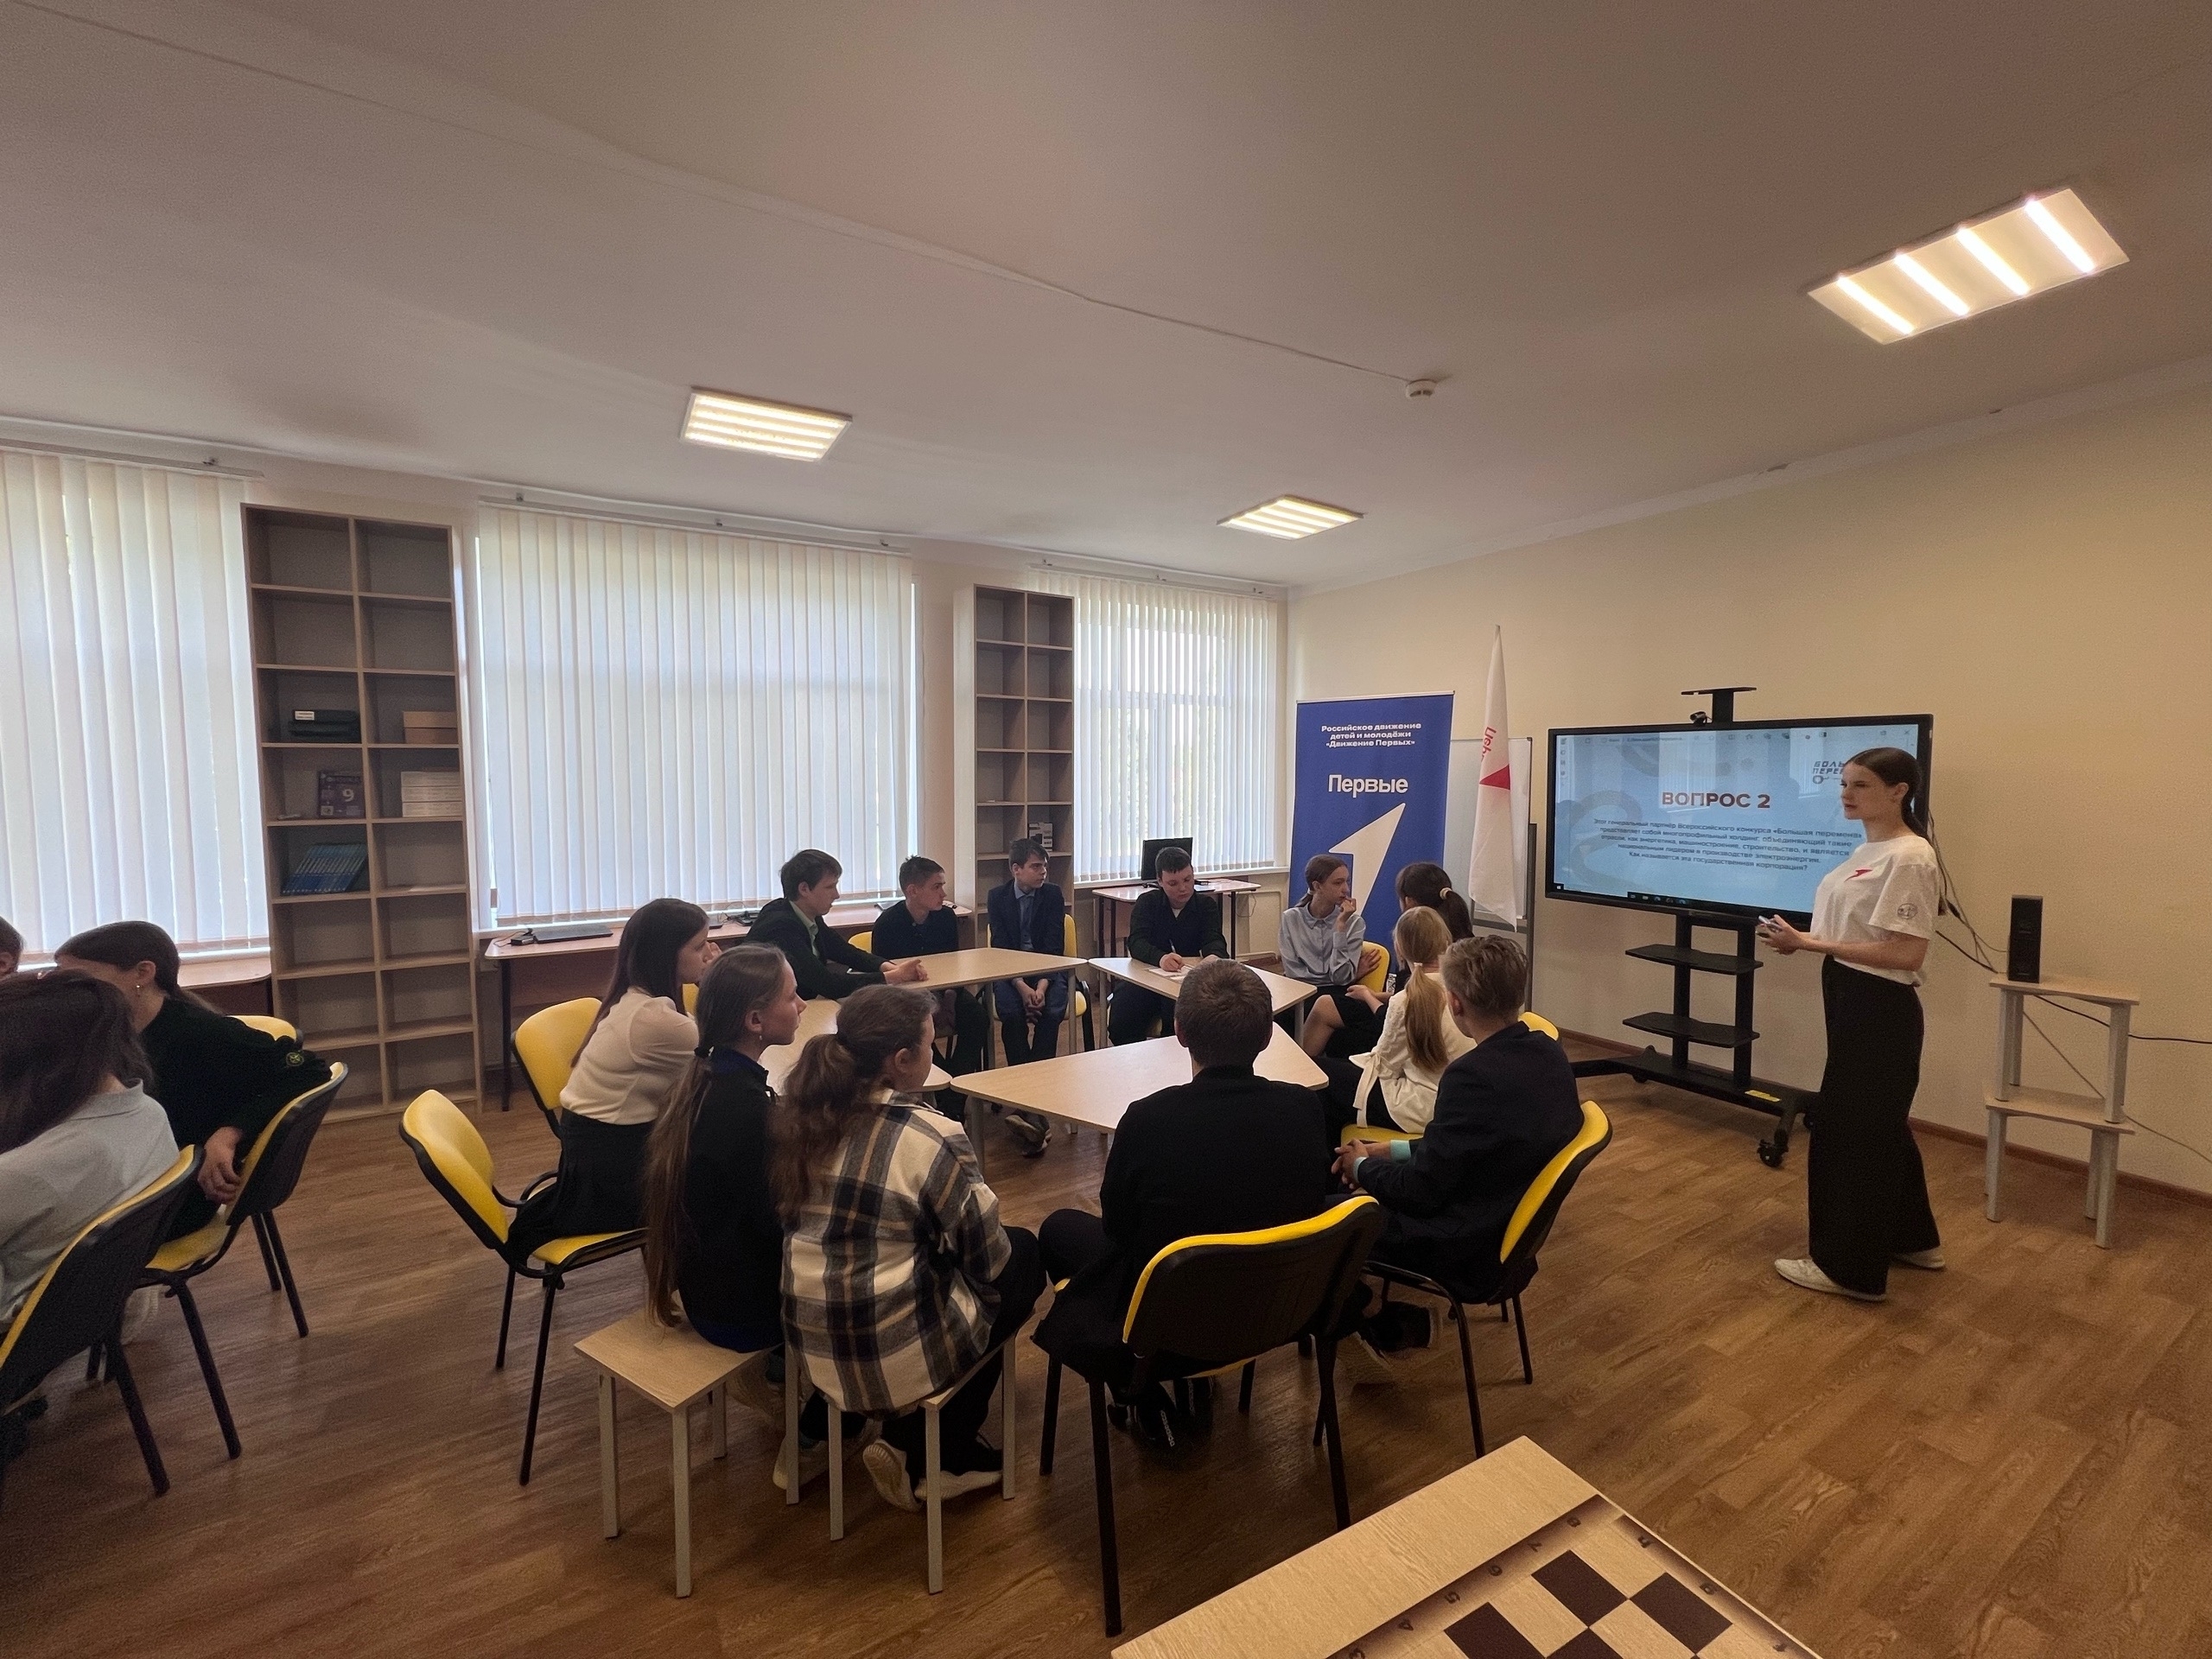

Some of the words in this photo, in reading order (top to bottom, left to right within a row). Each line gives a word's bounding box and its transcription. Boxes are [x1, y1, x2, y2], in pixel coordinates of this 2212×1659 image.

[1375, 739, 1415, 747] Первых»
[1328, 774, 1408, 798] Первые
[342, 788, 354, 802] 9
[1662, 791, 1751, 808] ВОПРОС
[1757, 793, 1770, 809] 2
[1677, 823, 1735, 832] Всероссийского
[1762, 836, 1826, 846] объединяющий
[1526, 1541, 1542, 1553] 7
[1445, 1592, 1460, 1604] 5
